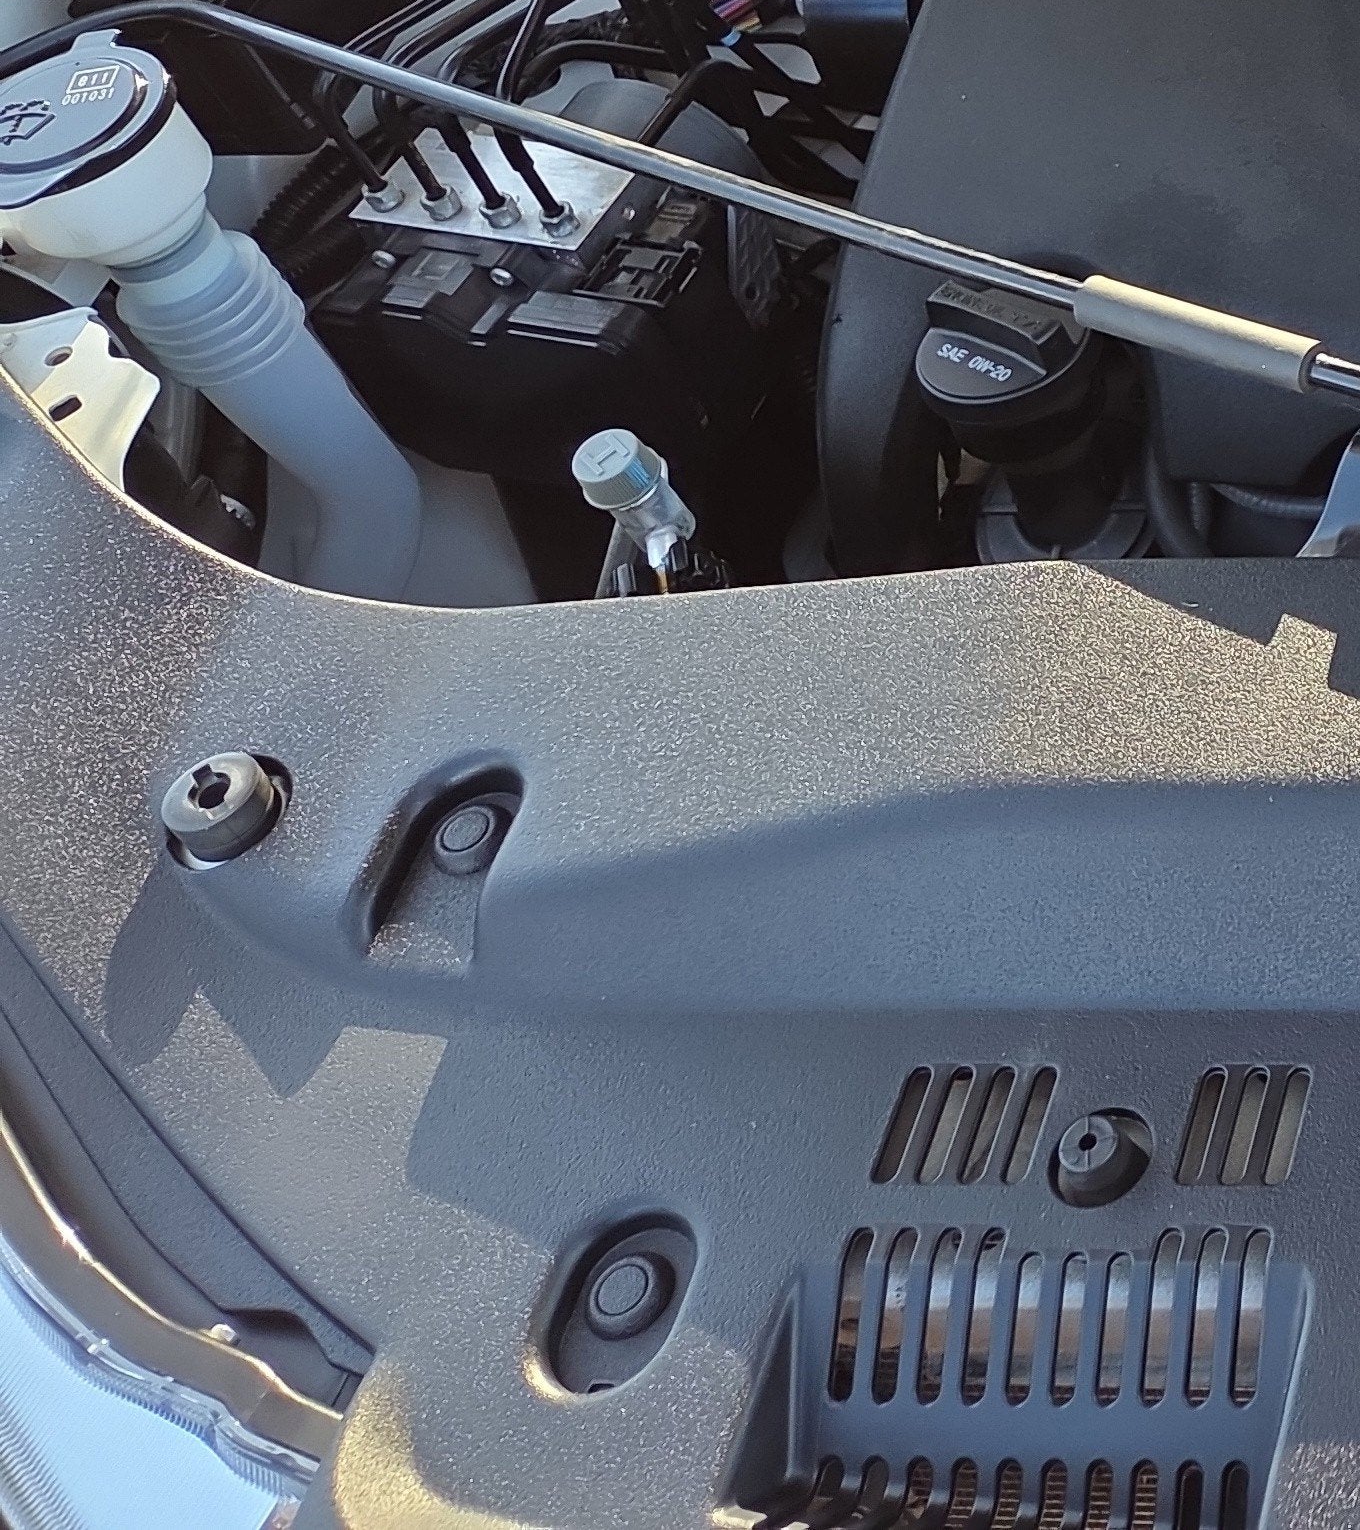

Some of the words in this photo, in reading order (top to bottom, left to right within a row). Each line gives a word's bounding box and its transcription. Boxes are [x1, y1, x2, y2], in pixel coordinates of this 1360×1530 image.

[61, 87, 115, 106] 001031
[936, 343, 970, 363] SAE
[967, 355, 1013, 382] 0W-20
